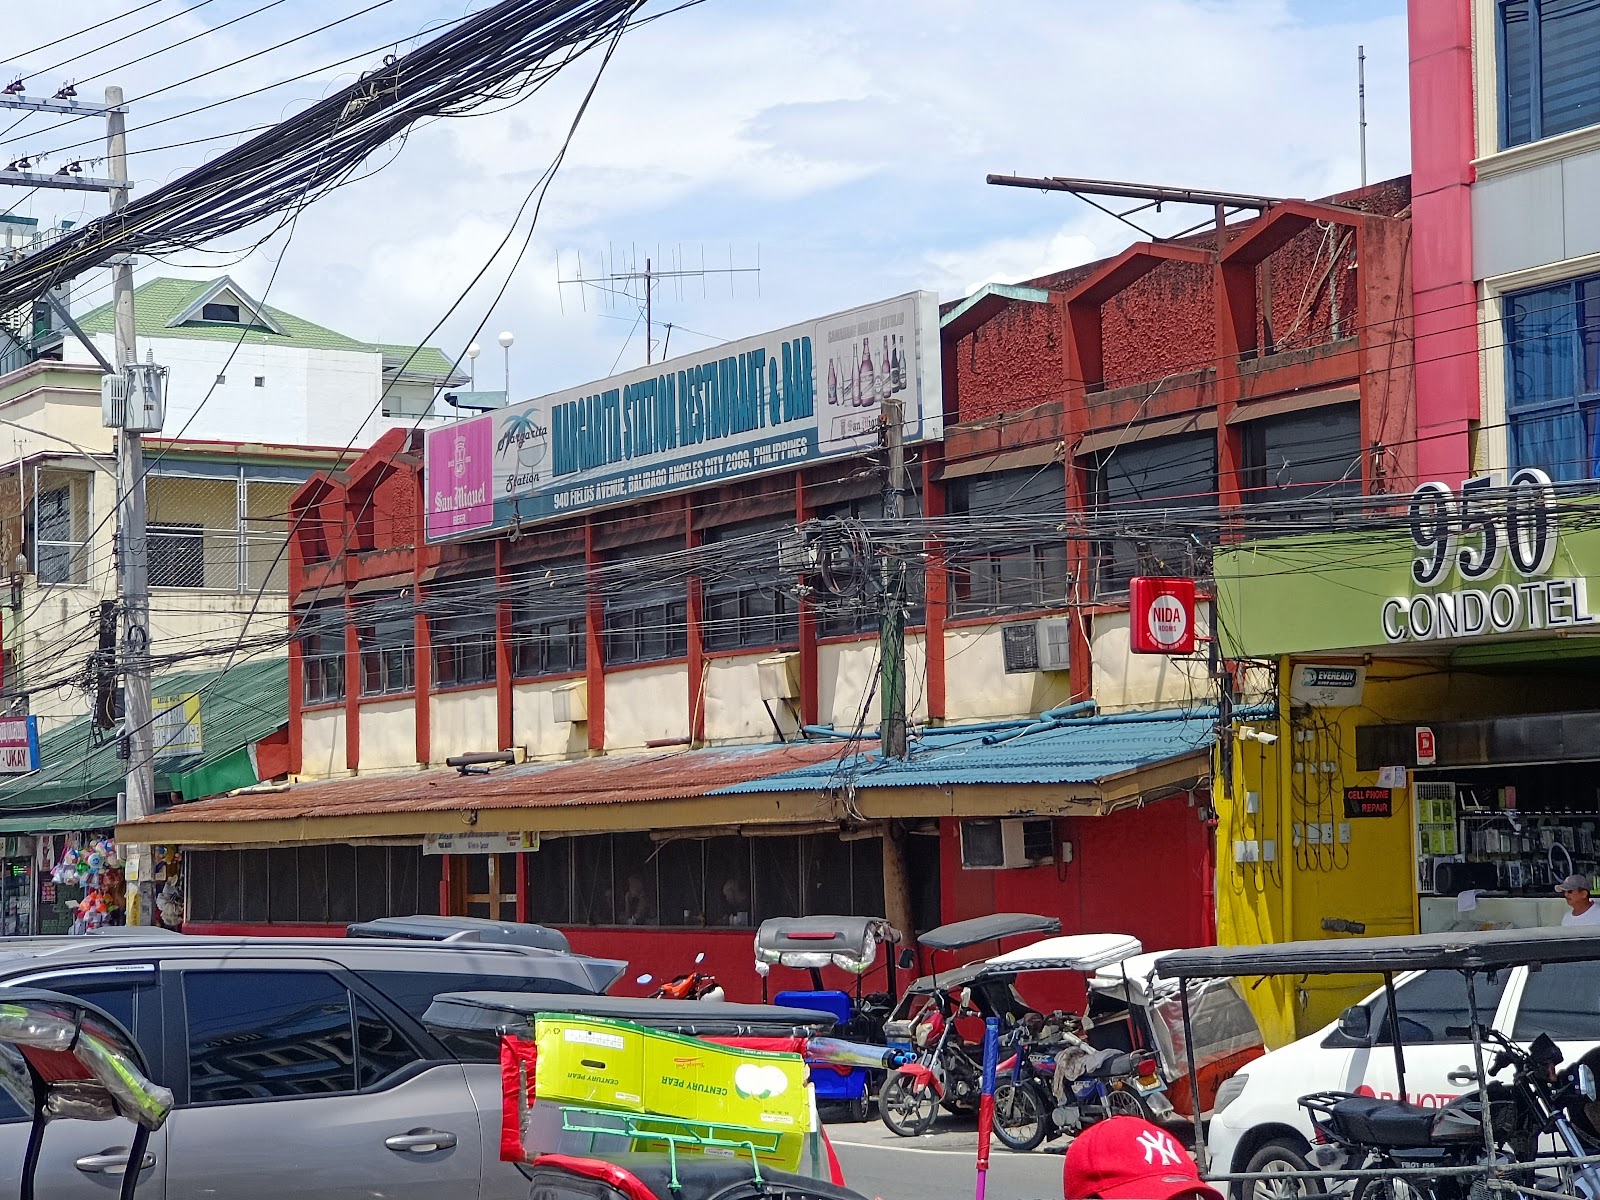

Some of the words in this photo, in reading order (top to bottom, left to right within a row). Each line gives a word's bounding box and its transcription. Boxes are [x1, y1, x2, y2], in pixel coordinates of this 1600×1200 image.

[552, 388, 622, 477] MARGARITA
[623, 373, 676, 460] STATION
[677, 348, 766, 448] RESTAURANT
[769, 356, 781, 427] &
[782, 336, 814, 423] BAR
[847, 419, 861, 432] San
[498, 426, 548, 451] Margarita
[554, 493, 569, 509] 940
[570, 485, 595, 506] FIELDS
[596, 478, 627, 500] AVENUE,
[628, 468, 667, 493] BALIBAGO
[668, 460, 703, 484] ANGELES
[704, 455, 724, 476] CITY
[726, 450, 752, 472] 2009,
[753, 437, 808, 465] PHILIPPINES
[505, 472, 540, 493] Station
[434, 491, 453, 513] San
[453, 481, 486, 512] Miguel
[453, 513, 466, 525] BEER
[1409, 468, 1558, 587] 950
[1153, 607, 1181, 623] NIDA
[1381, 577, 1596, 643] CONDOTEL
[1318, 670, 1355, 681] EVEREADY
[6, 749, 26, 767] UKAY
[1348, 791, 1364, 800] CELL
[1365, 790, 1389, 799] PHONE
[1361, 803, 1388, 812] REPAIR
[567, 1072, 586, 1081] PEAR
[586, 1074, 619, 1085] CENTURY
[661, 1075, 685, 1088] PEAR
[686, 1081, 728, 1096] CENTURY
[1136, 1130, 1182, 1166] NY
